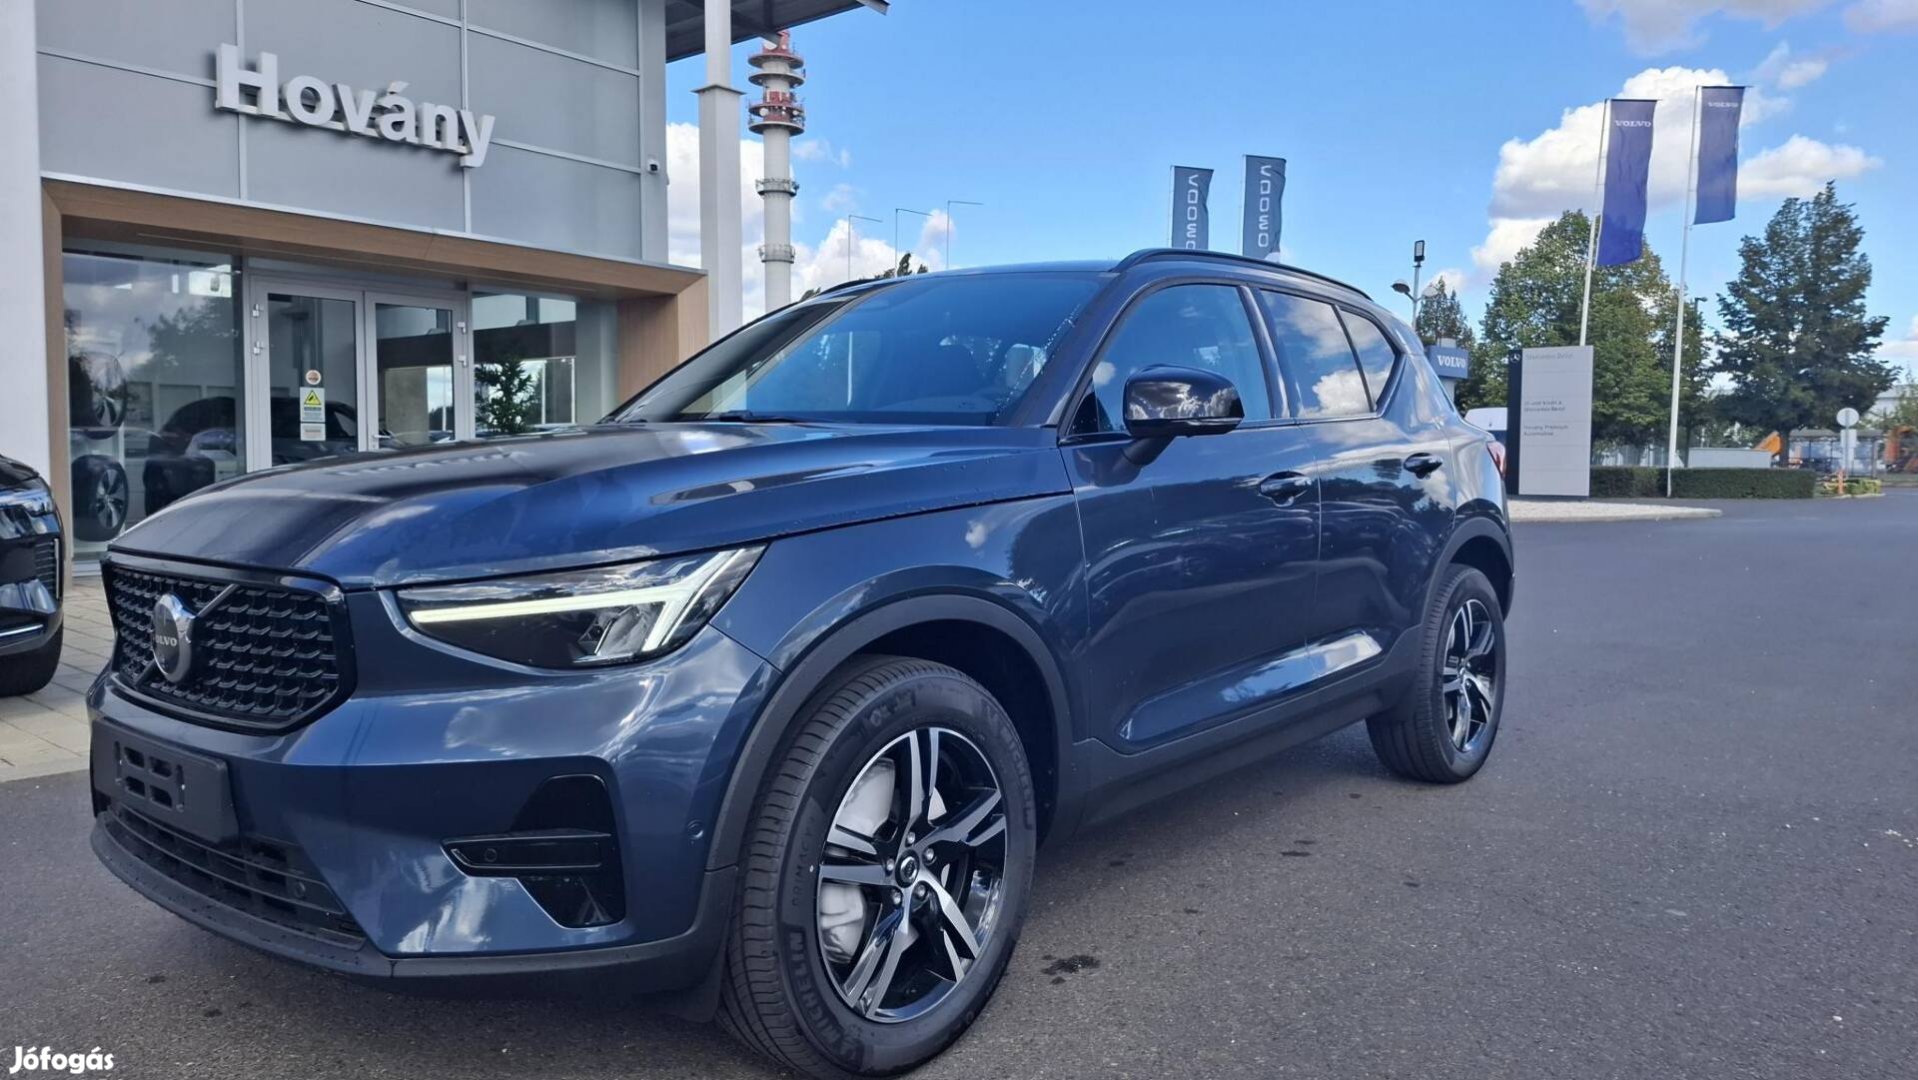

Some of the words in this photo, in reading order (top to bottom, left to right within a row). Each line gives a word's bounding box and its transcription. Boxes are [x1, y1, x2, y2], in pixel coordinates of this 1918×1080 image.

[215, 43, 496, 168] Hovány
[1615, 120, 1652, 128] VOLVO
[1437, 355, 1466, 369] VOLVO
[155, 634, 178, 647] OLVO
